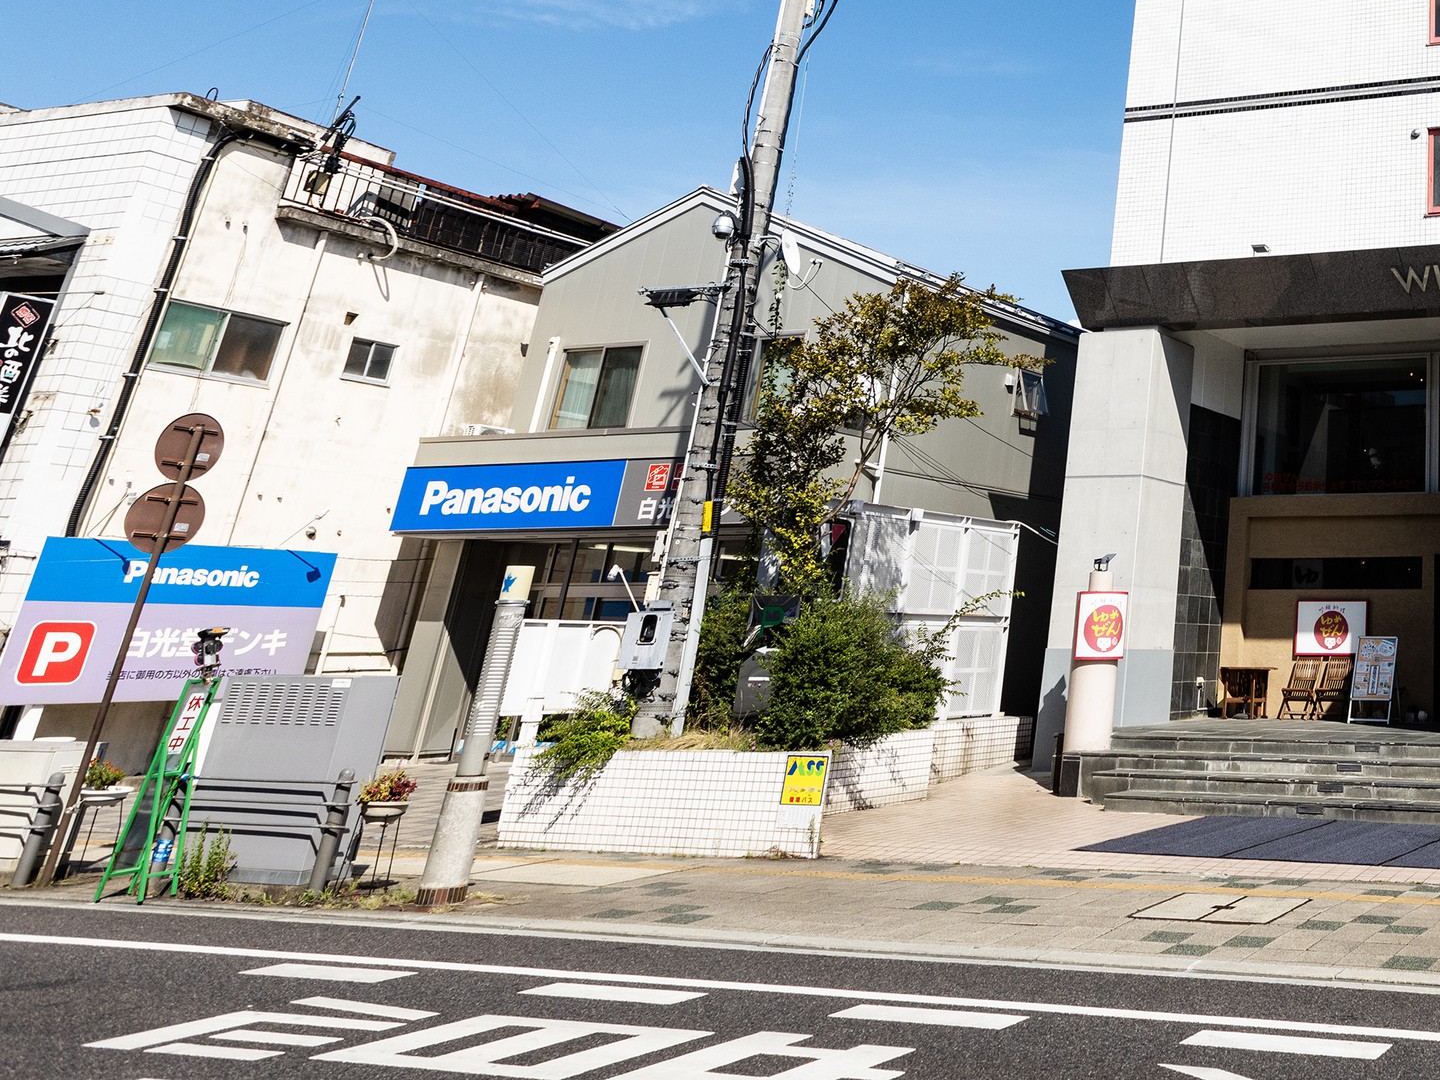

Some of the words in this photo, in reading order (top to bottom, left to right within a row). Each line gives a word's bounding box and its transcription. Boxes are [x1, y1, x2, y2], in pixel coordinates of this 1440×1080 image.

[419, 476, 591, 516] Panasonic
[123, 560, 260, 587] Panasonic
[31, 631, 83, 676] P
[168, 695, 204, 750] 休工中
